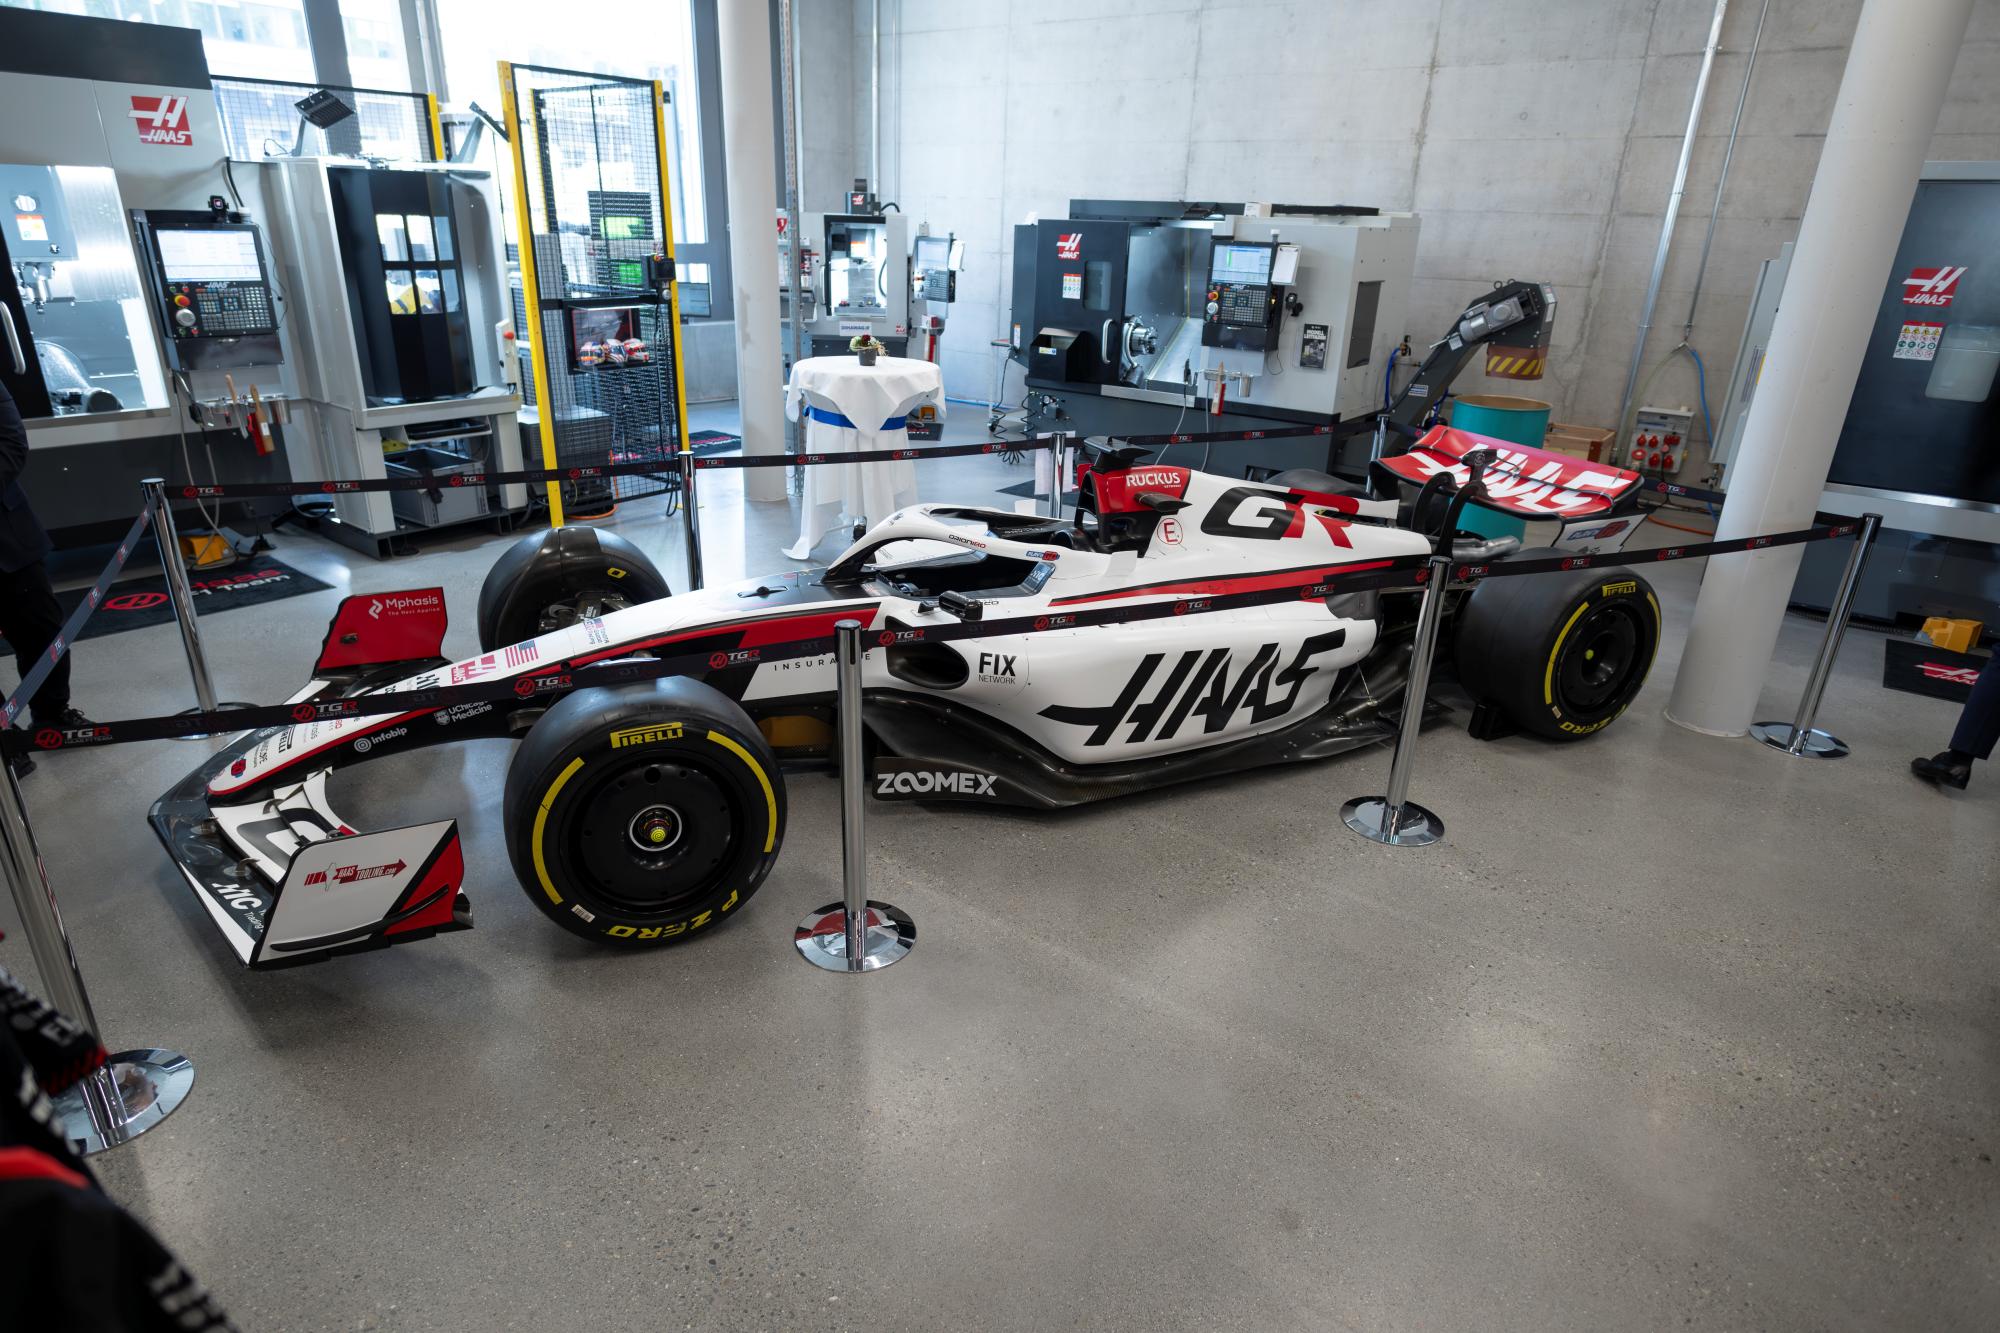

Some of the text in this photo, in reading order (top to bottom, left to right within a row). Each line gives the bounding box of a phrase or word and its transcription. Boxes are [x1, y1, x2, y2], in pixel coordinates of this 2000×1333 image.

[140, 129, 191, 144] HAAS
[205, 281, 230, 289] HAAS
[1903, 293, 1953, 305] HAAS
[1126, 473, 1181, 487] RUCKUS
[1200, 487, 1360, 549] GR
[1470, 566, 1488, 574] TGR
[216, 574, 290, 591] Team
[1602, 581, 1636, 597] PIRELLI
[386, 595, 438, 610] Mphasis
[1188, 600, 1212, 609] TGR
[1050, 615, 1075, 624] TGR
[896, 629, 925, 639] TGR
[728, 650, 760, 660] TGR
[774, 653, 871, 672] INSURAE
[979, 652, 1017, 677] FIX
[536, 675, 571, 687] TGR
[978, 674, 1016, 685] NETWORK
[1037, 628, 1346, 746] HAAS
[316, 700, 358, 712] TGR
[451, 704, 493, 722] Medicine
[63, 726, 111, 739] TGR
[1560, 716, 1612, 734] ZERO
[371, 727, 408, 745] infobip
[610, 722, 683, 749] PIRELLI
[877, 771, 1000, 797] ZOOMEX
[338, 867, 356, 878] HAAS
[721, 889, 739, 912] P
[606, 909, 713, 940] ZERO
